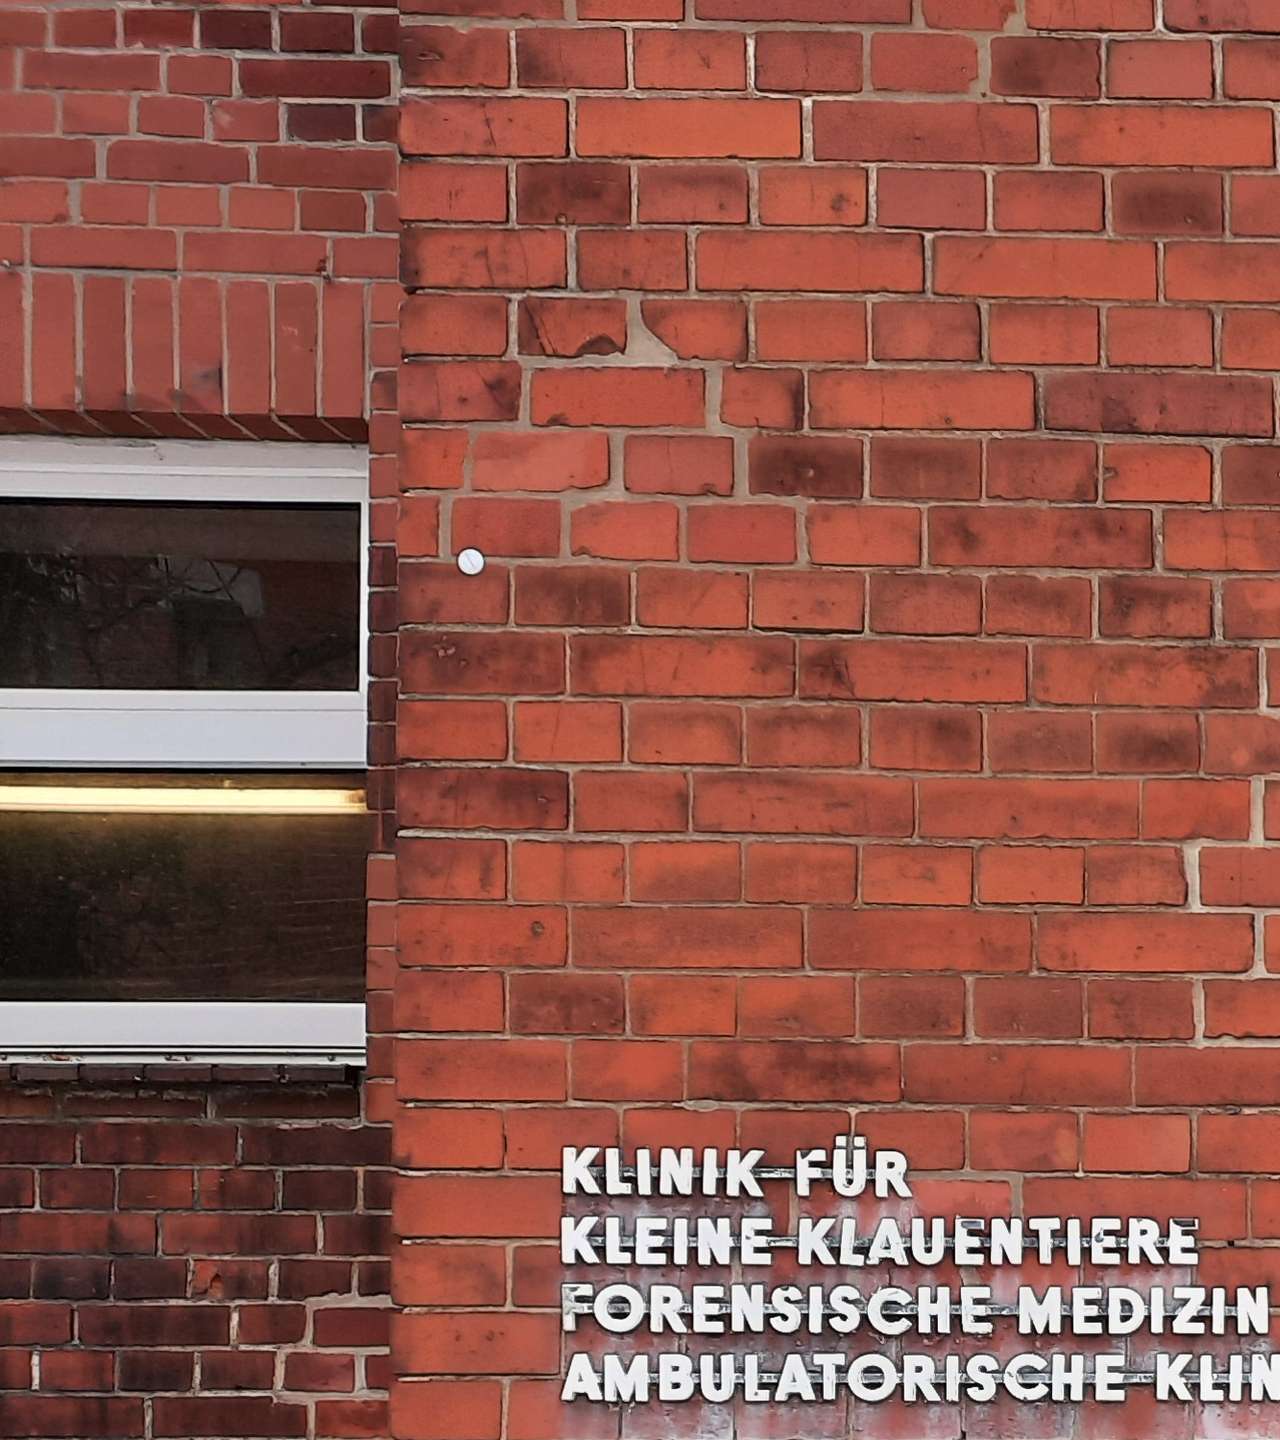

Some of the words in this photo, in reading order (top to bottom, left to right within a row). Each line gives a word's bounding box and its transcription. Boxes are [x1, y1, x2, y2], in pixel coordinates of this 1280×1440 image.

[562, 1145, 766, 1197] KLINIK
[795, 1135, 913, 1198] FÜR
[561, 1215, 772, 1265] KLEINE
[796, 1216, 1199, 1267] KLAUENTIERE
[561, 1282, 993, 1335] FORENSISCHE
[1017, 1285, 1269, 1335] MEDIZIN
[561, 1352, 1127, 1403] AMBULATORISCHE
